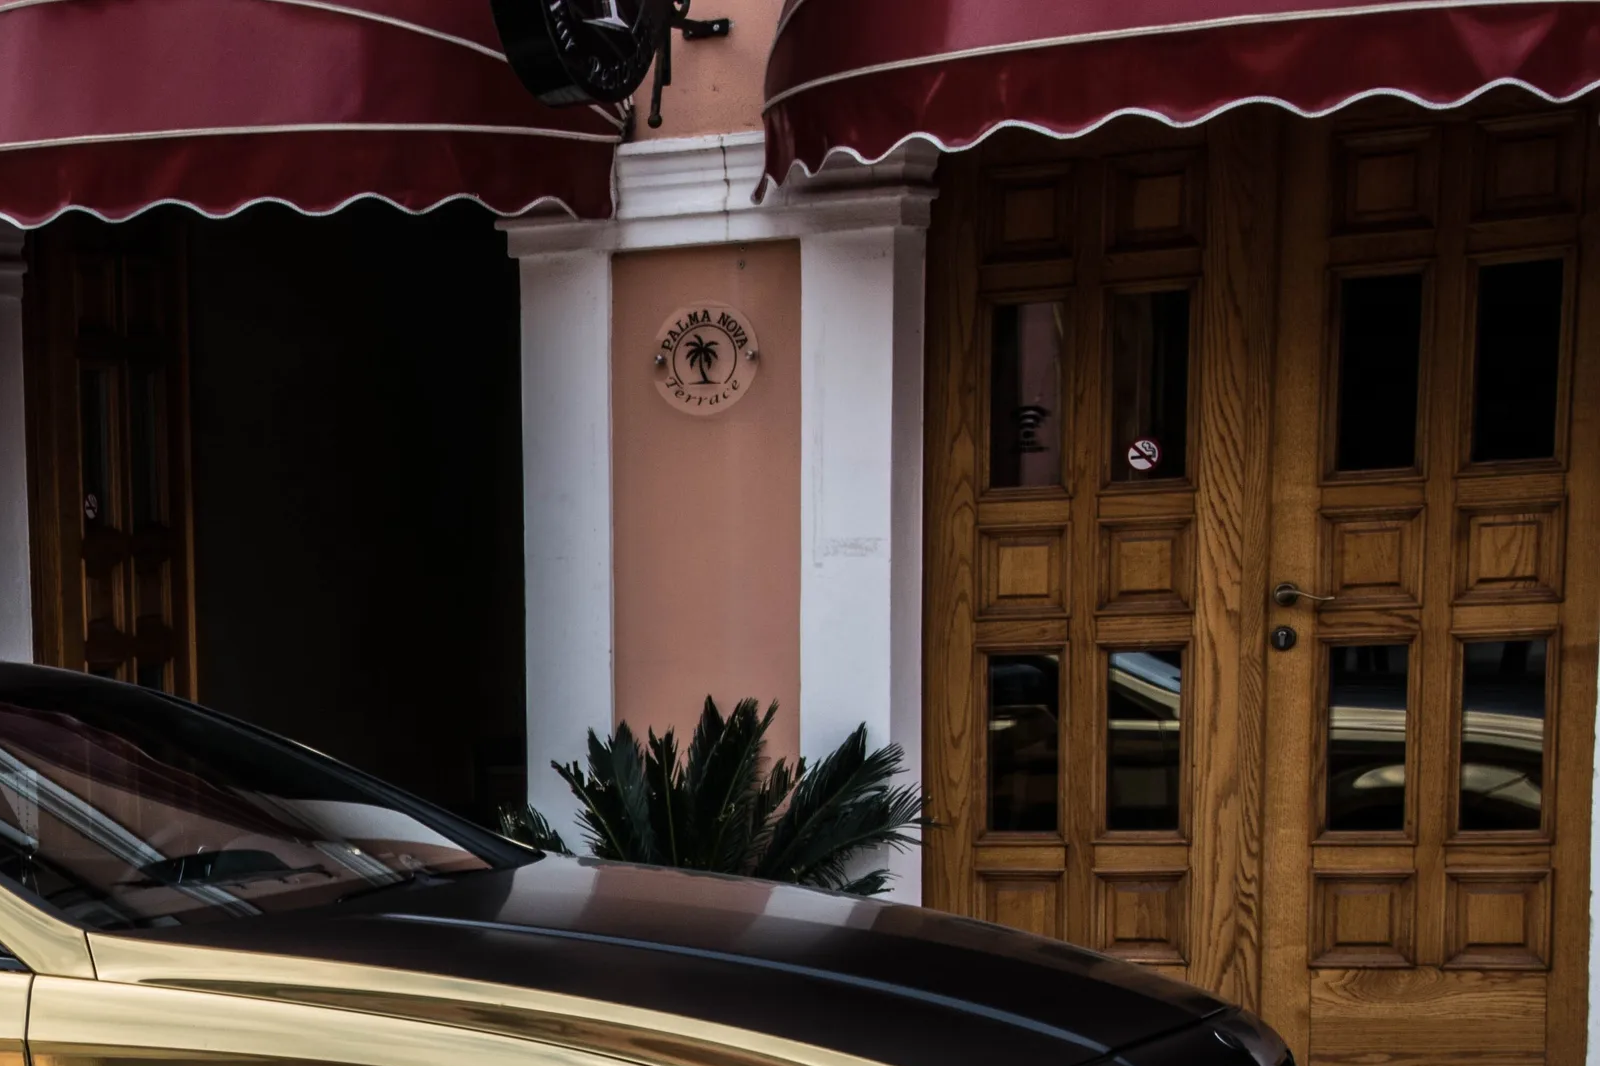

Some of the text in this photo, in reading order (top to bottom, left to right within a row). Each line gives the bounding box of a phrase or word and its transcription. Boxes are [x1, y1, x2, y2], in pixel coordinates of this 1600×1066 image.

[662, 309, 748, 352] PALMA NOVA
[665, 376, 740, 406] Terrace
